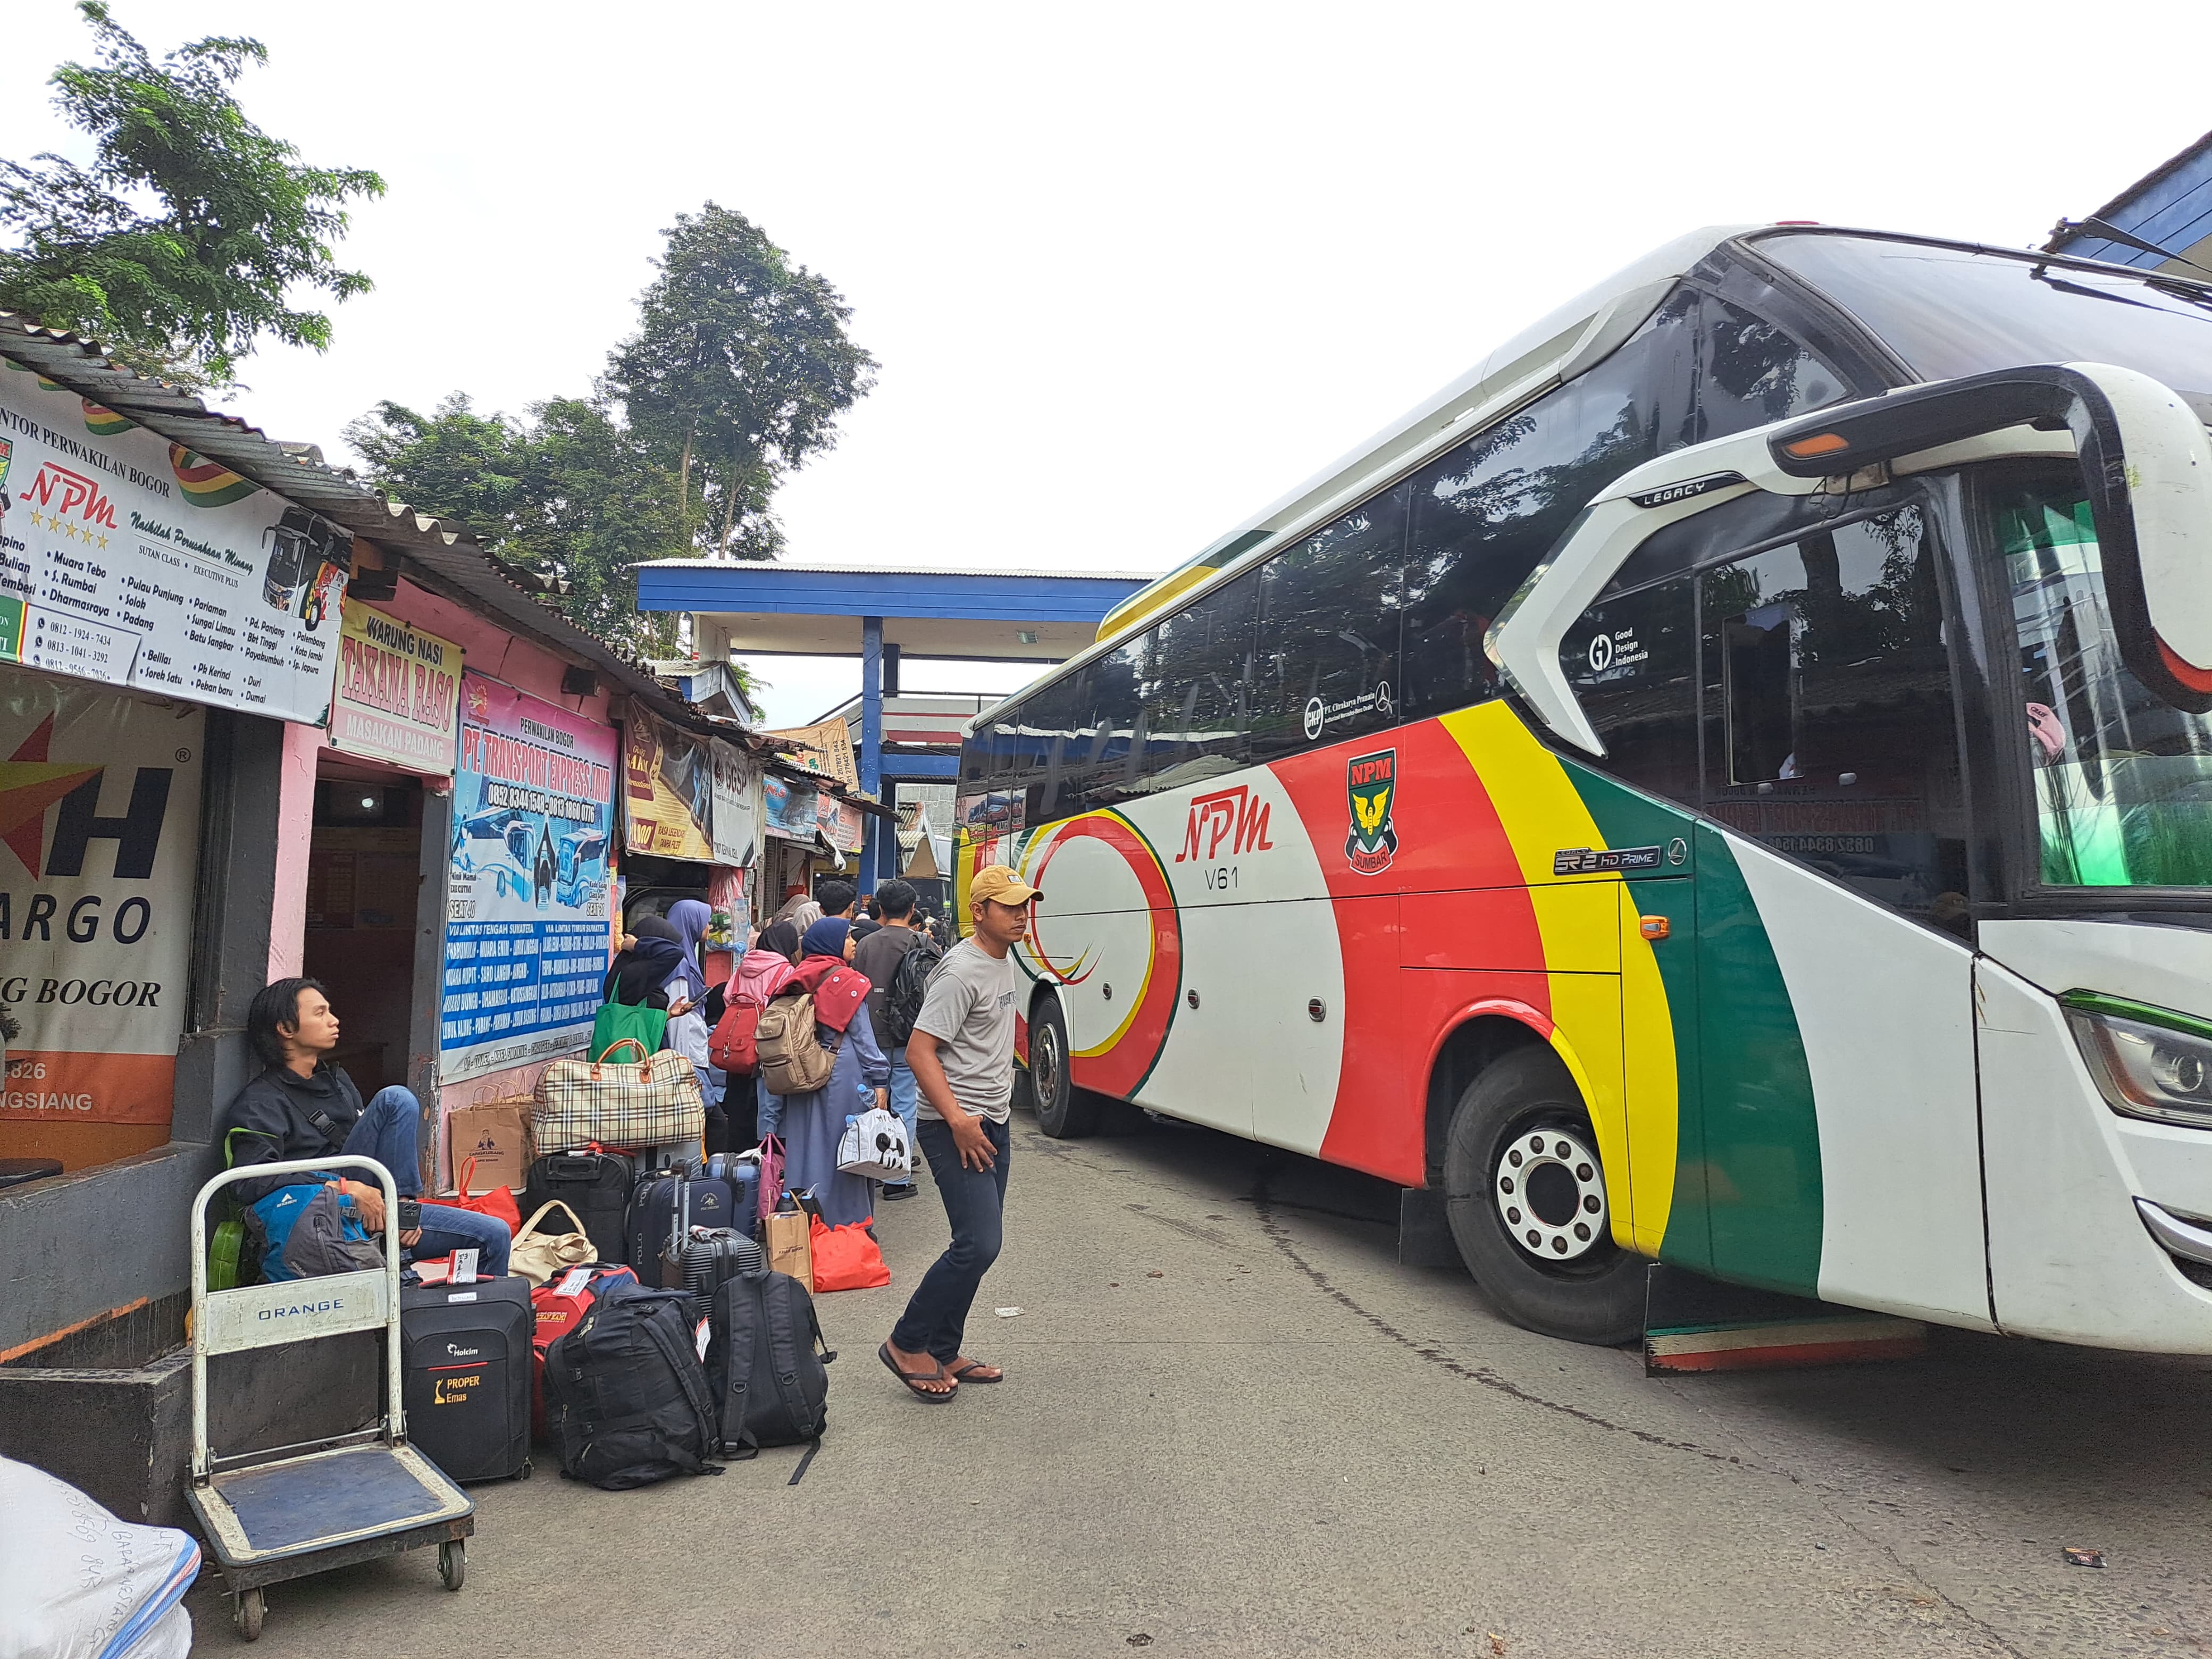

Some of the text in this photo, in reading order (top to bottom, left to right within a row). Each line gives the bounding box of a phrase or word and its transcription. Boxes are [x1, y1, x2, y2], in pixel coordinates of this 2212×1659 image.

[43, 427, 127, 479] PERWAKILAN
[129, 467, 170, 498] BOGOR
[19, 461, 118, 529] NPM
[1643, 482, 1706, 505] LEGACY
[130, 511, 253, 576] Naikilah Perusahaan Minang
[54, 550, 106, 579] Muara Tebo
[138, 545, 180, 567] SUTAN CLASS
[52, 569, 97, 594] S. Rumbai
[193, 565, 238, 588] EXECUTIVE PLUS
[127, 576, 184, 605] Pulau Punjung
[49, 589, 110, 617] Dharmasraya
[125, 593, 146, 610] Solok
[123, 611, 154, 631] Padang
[215, 622, 236, 636] Limau
[249, 617, 285, 638] Pd. Panjang
[51, 622, 111, 647] 0812 1924 7434
[189, 630, 234, 651] Batu Sangkar
[247, 632, 278, 650] Bkt Tinggi
[297, 631, 325, 649] Palembang
[366, 616, 442, 666] WARUNG NASI
[1615, 627, 1633, 641] Good
[47, 639, 107, 664] 0813 1041 3292
[147, 650, 171, 665] Belilas
[245, 647, 284, 667] Payakumbuh
[295, 645, 323, 661] Kota Jambi
[1615, 640, 1638, 655] Design
[1615, 649, 1648, 666] Indonesia
[145, 666, 182, 685] Sorek Satu
[198, 663, 231, 680] Pk Kerinci
[301, 661, 319, 674] Japura
[196, 678, 233, 697] Pekan baru
[248, 675, 261, 688] Duri
[341, 635, 454, 733] TAKANA RASO
[246, 691, 266, 703] Dumai
[347, 714, 443, 760] MASAKAN PADANG
[520, 717, 574, 749] PERWAKILAN BOGOR
[462, 724, 610, 803] PT. TRANSPORT EXPRESS JAYA
[1351, 757, 1392, 786] NPM
[488, 782, 508, 807] 0852
[509, 787, 529, 811] 8344
[529, 791, 545, 814] 1548
[548, 797, 564, 818] 0813
[565, 798, 580, 820] 1860
[1175, 784, 1273, 863] NPM
[1355, 852, 1387, 870] SUMBAR
[1622, 853, 1654, 865] PRIME
[1205, 866, 1238, 891] V61
[450, 900, 467, 919] SEAT
[586, 902, 599, 916] SEAT
[449, 925, 459, 936] VIA
[459, 924, 482, 935] LINTAS
[482, 924, 508, 935] TENGAH
[545, 924, 554, 933] VIA
[35, 978, 161, 1007] BOGOR
[258, 1298, 344, 1320] ORANGE
[454, 1347, 478, 1357] Holcim
[447, 1375, 480, 1389] PROPER
[447, 1393, 467, 1403] Emas
